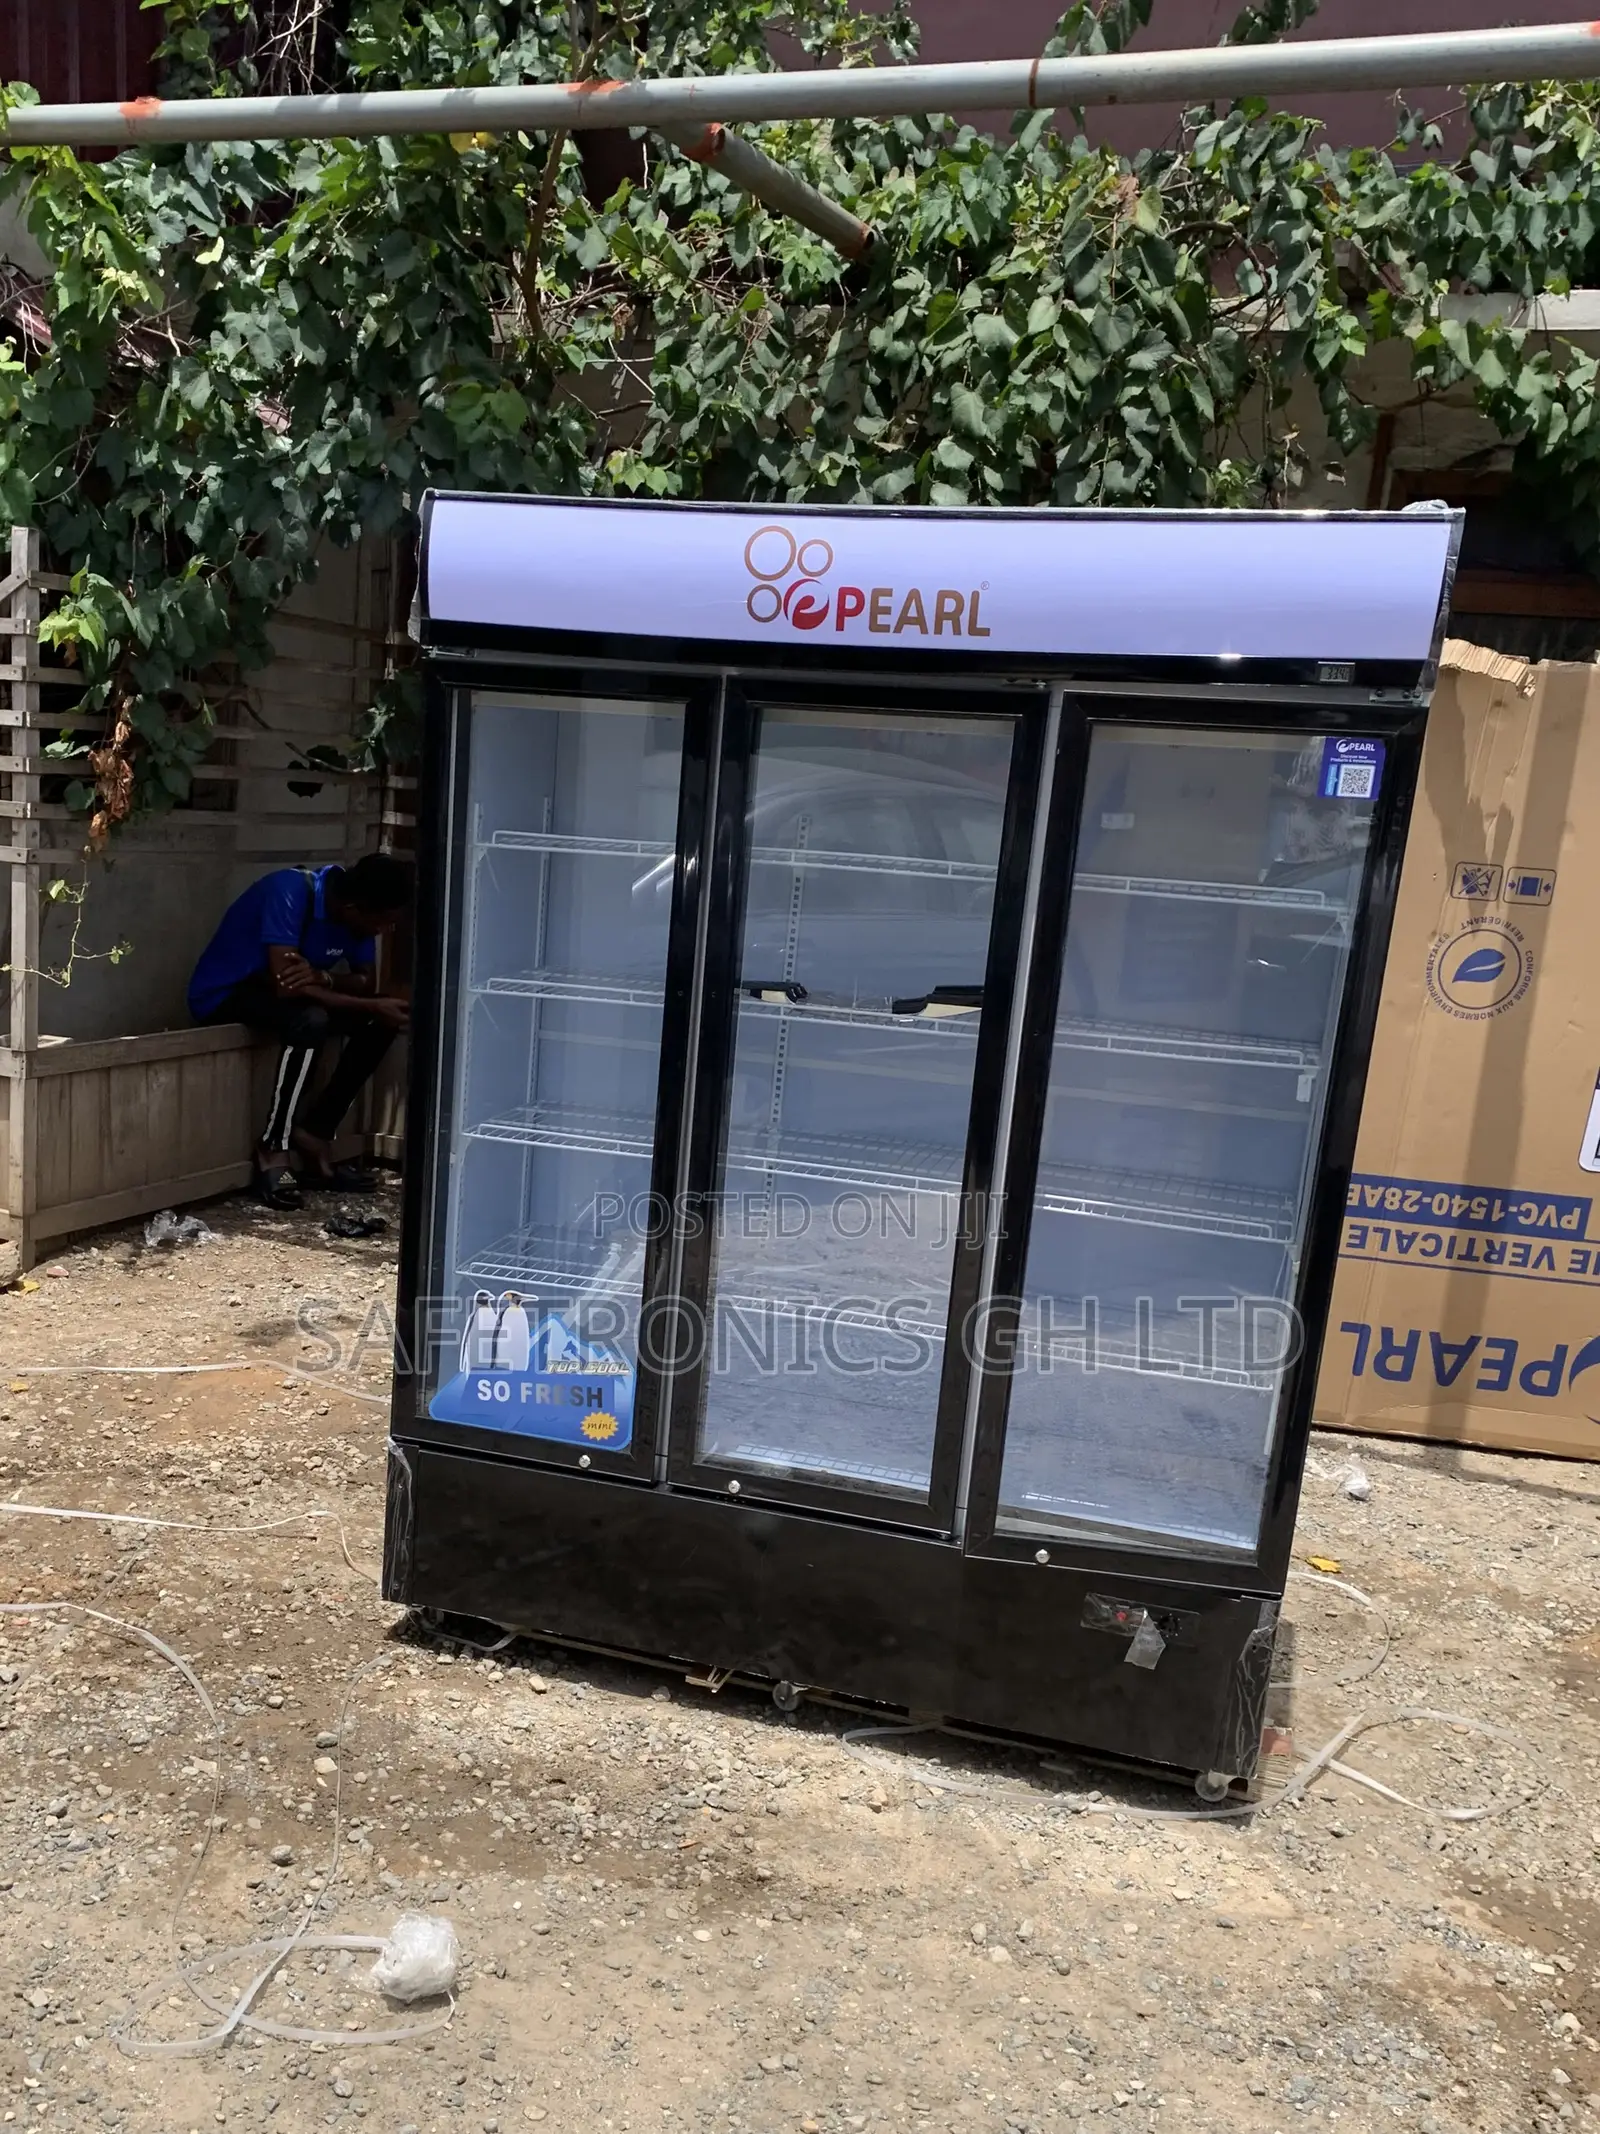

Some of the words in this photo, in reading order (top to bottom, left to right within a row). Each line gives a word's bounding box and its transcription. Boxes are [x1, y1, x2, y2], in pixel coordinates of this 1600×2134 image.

[836, 586, 991, 637] PEARL
[1350, 743, 1375, 751] PEARL
[1454, 1010, 1494, 1020] NORMES
[1496, 1000, 1514, 1014] AUX
[1346, 1225, 1556, 1271] VERTICALE
[546, 1359, 581, 1375] TOP
[584, 1360, 632, 1376] COOL
[1340, 1321, 1569, 1397] PEARL
[477, 1379, 511, 1402] SO
[520, 1382, 603, 1408] FRESH
[587, 1420, 613, 1431] mini
